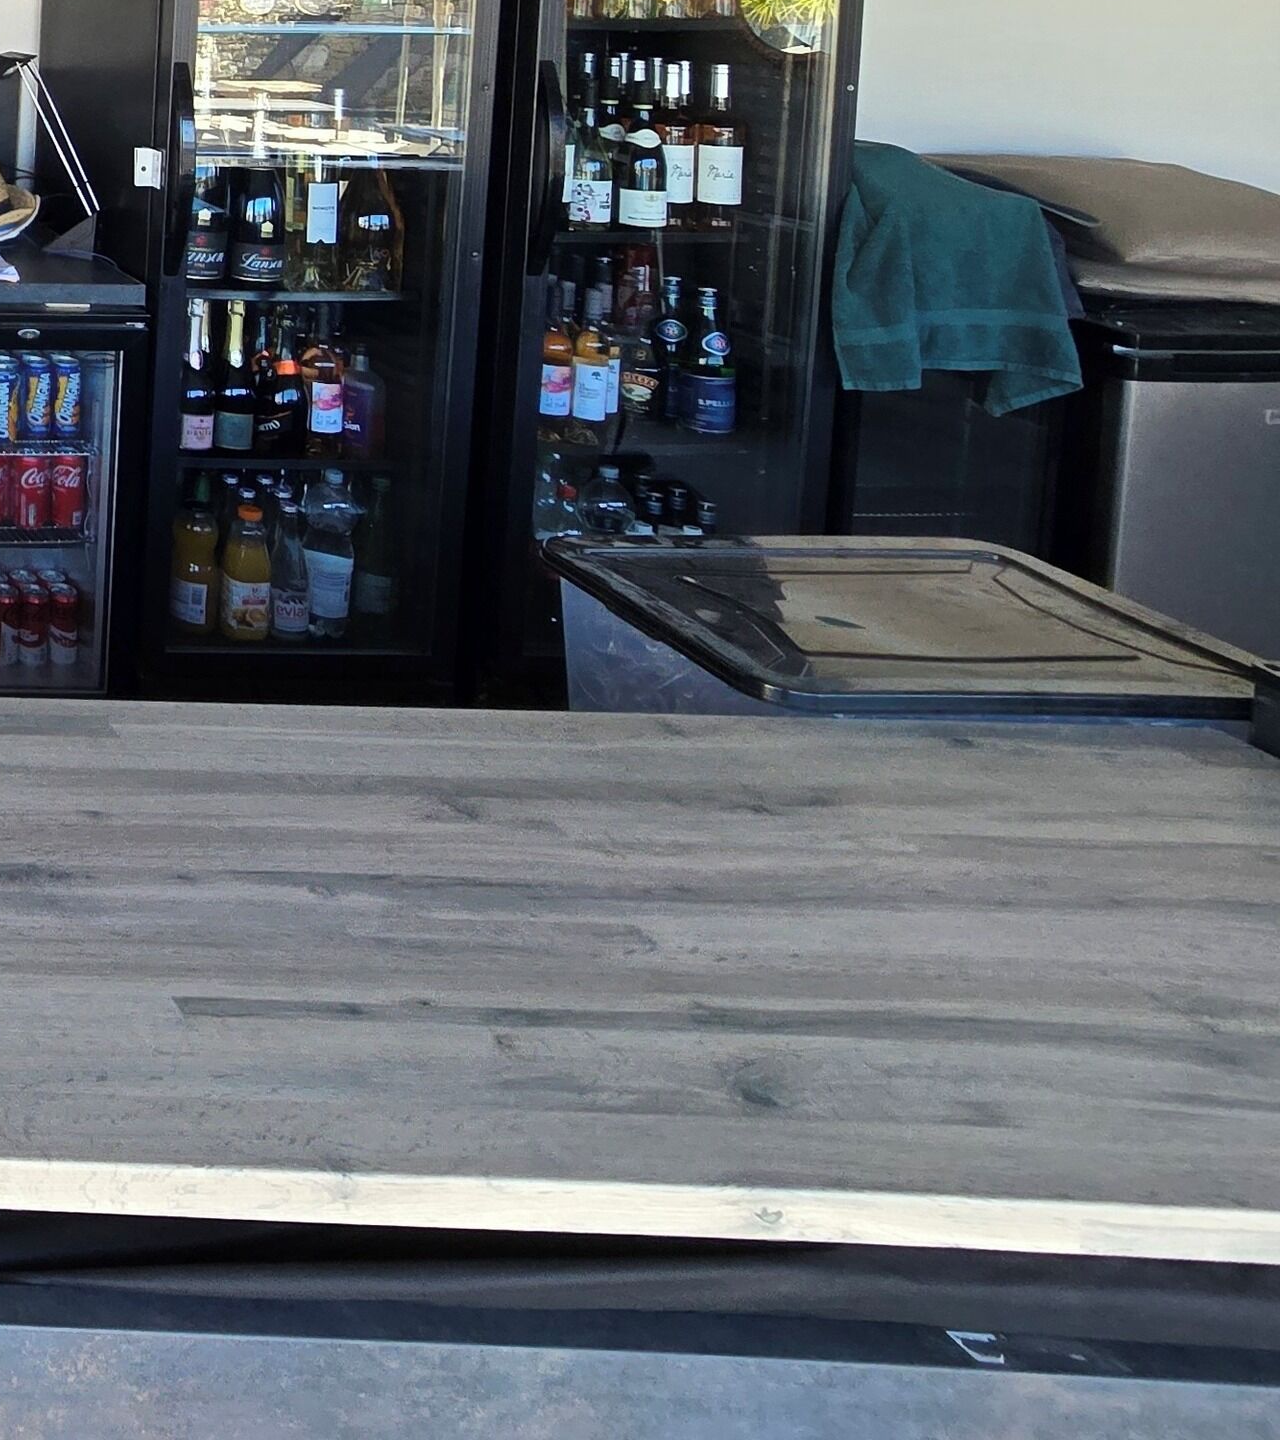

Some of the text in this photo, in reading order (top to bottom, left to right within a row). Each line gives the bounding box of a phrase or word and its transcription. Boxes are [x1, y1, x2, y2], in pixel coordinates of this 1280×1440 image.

[708, 163, 734, 181] Marie
[28, 372, 50, 426] ORANGINA
[55, 372, 81, 425] ORANGINA
